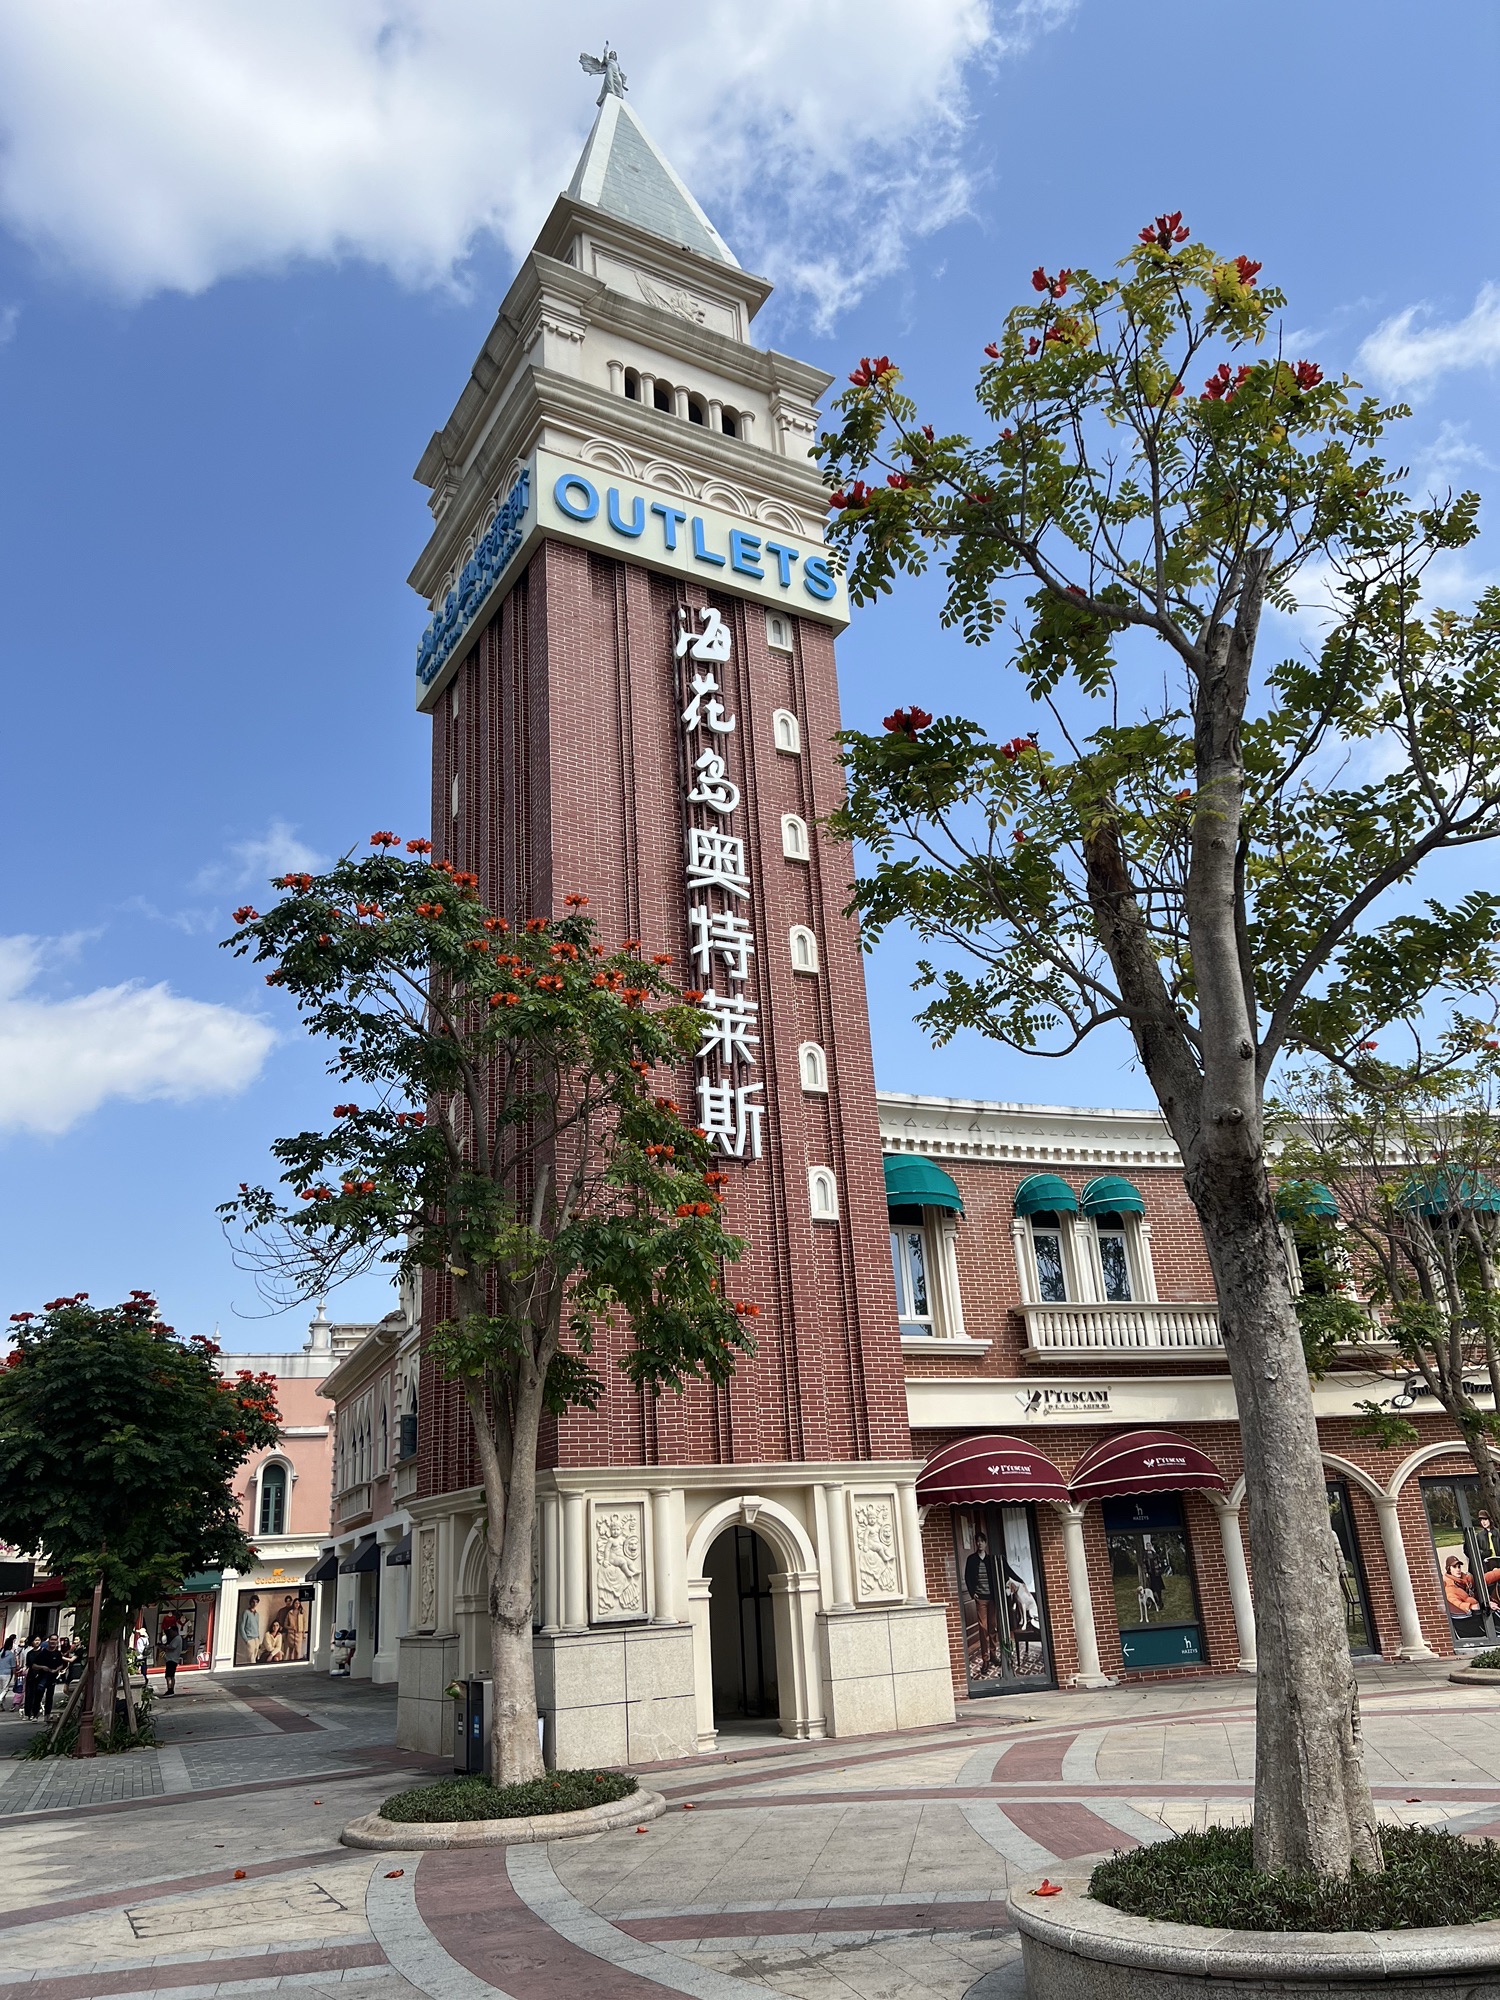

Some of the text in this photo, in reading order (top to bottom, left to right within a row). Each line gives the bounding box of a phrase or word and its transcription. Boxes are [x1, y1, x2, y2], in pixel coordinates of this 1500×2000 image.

[553, 473, 838, 600] OUTLETS
[676, 606, 765, 1160] 海花岛奥特莱斯
